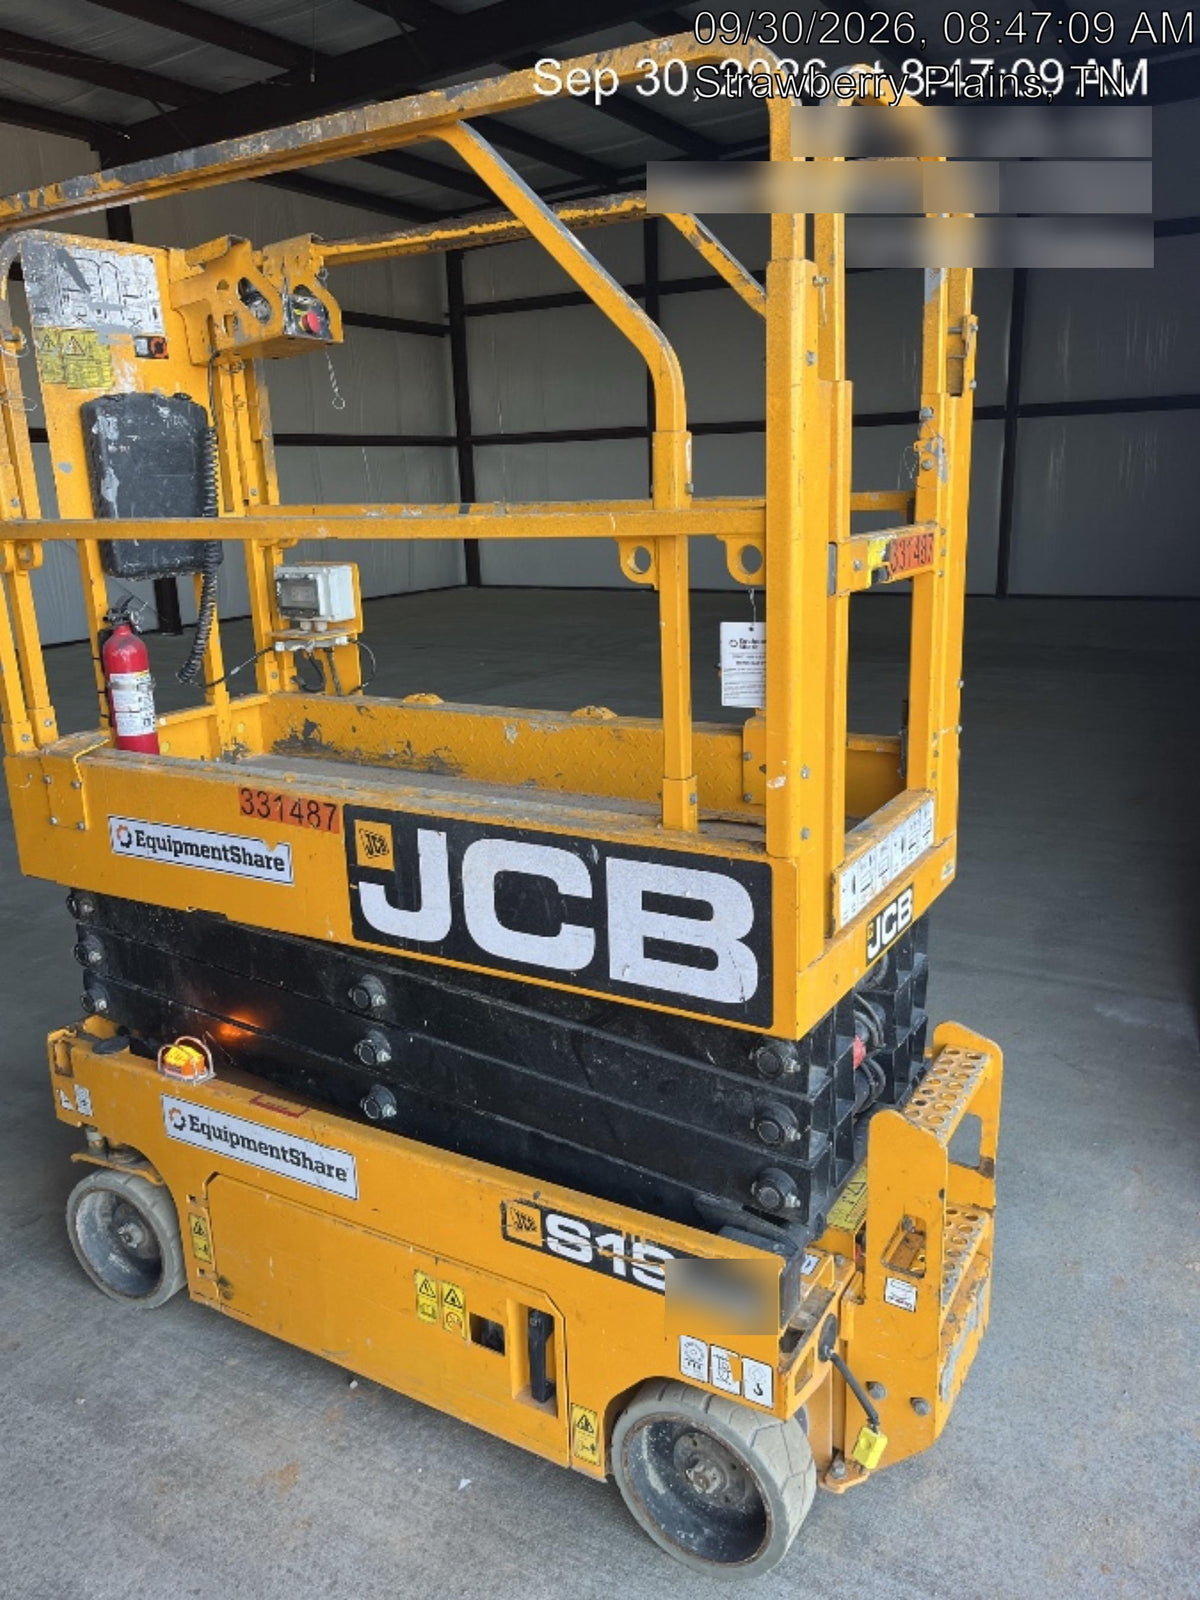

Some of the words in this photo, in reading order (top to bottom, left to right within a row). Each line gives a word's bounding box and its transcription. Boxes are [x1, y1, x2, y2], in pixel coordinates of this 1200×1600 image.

[240, 787, 337, 831] 331487
[135, 829, 285, 873] EquipmentShare
[358, 828, 759, 1003] JCB
[867, 888, 913, 959] JCB
[188, 1113, 348, 1182] EquipmentShare
